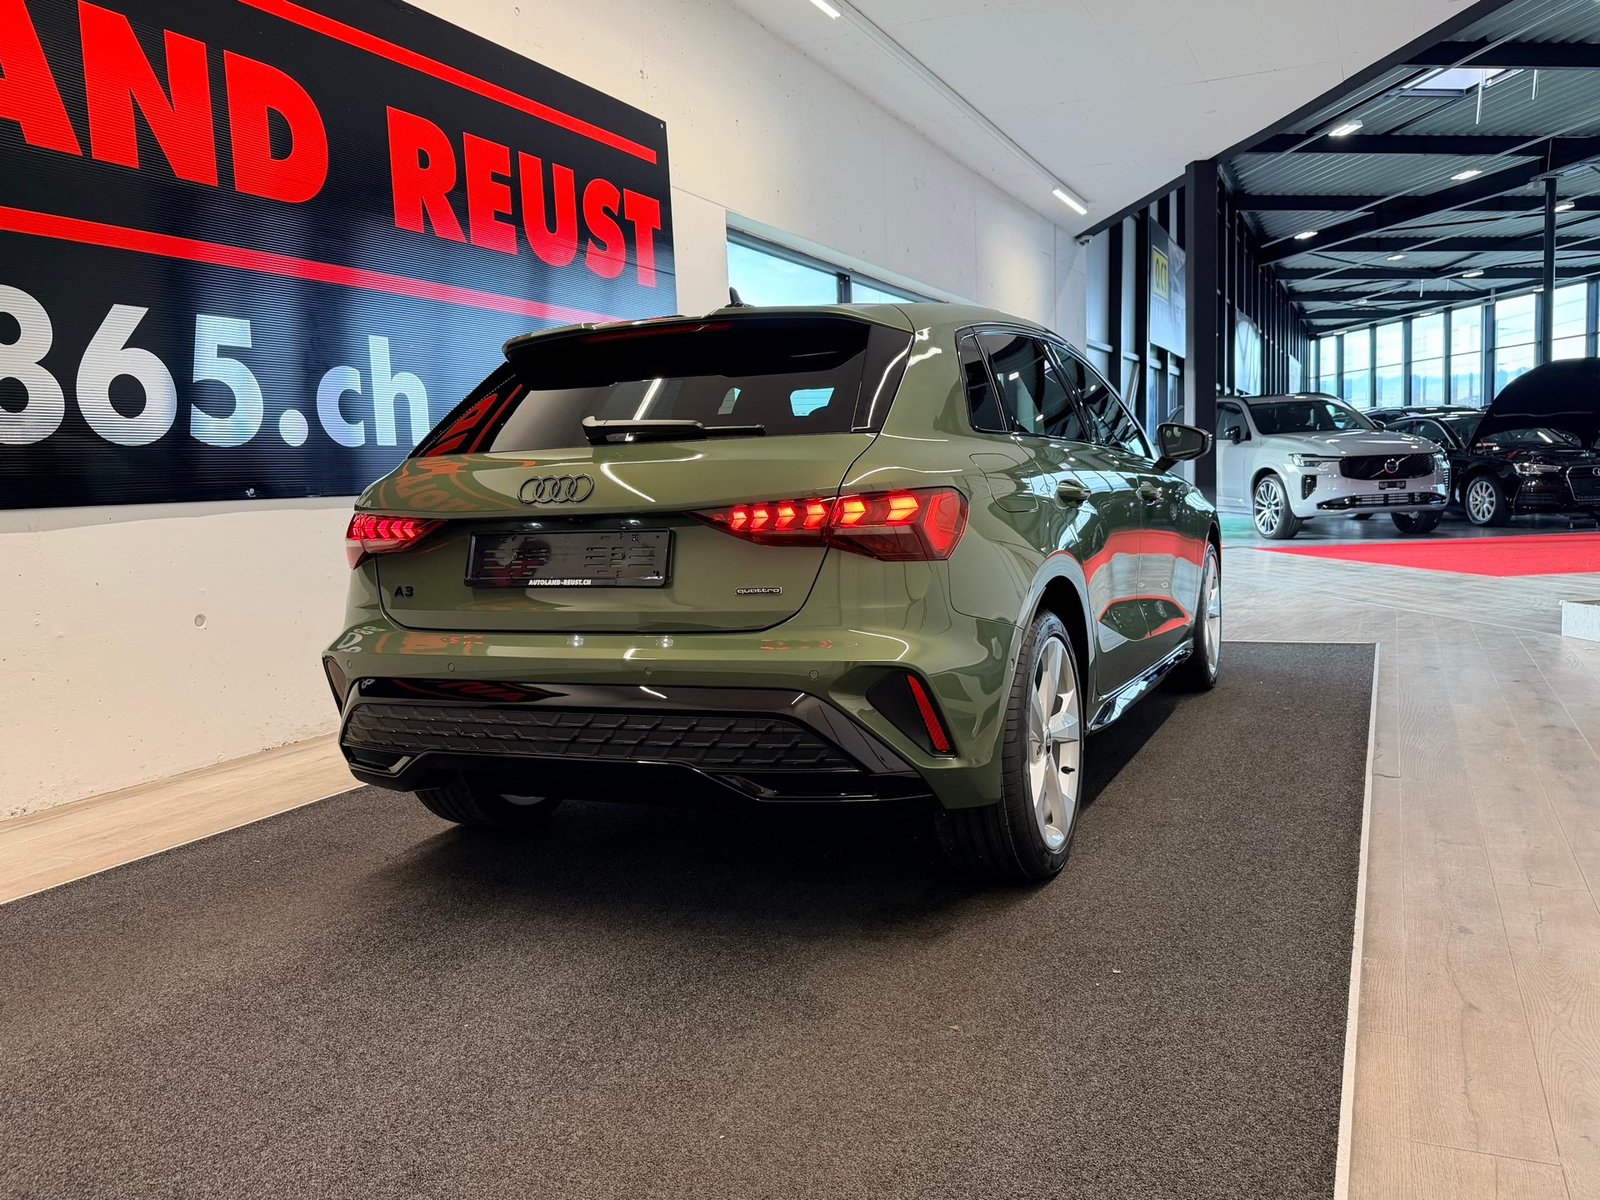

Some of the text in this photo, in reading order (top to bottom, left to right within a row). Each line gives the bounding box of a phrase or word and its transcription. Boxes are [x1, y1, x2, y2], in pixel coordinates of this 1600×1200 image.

[386, 105, 661, 288] REUST
[394, 585, 414, 598] A3
[736, 587, 781, 595] quattro
